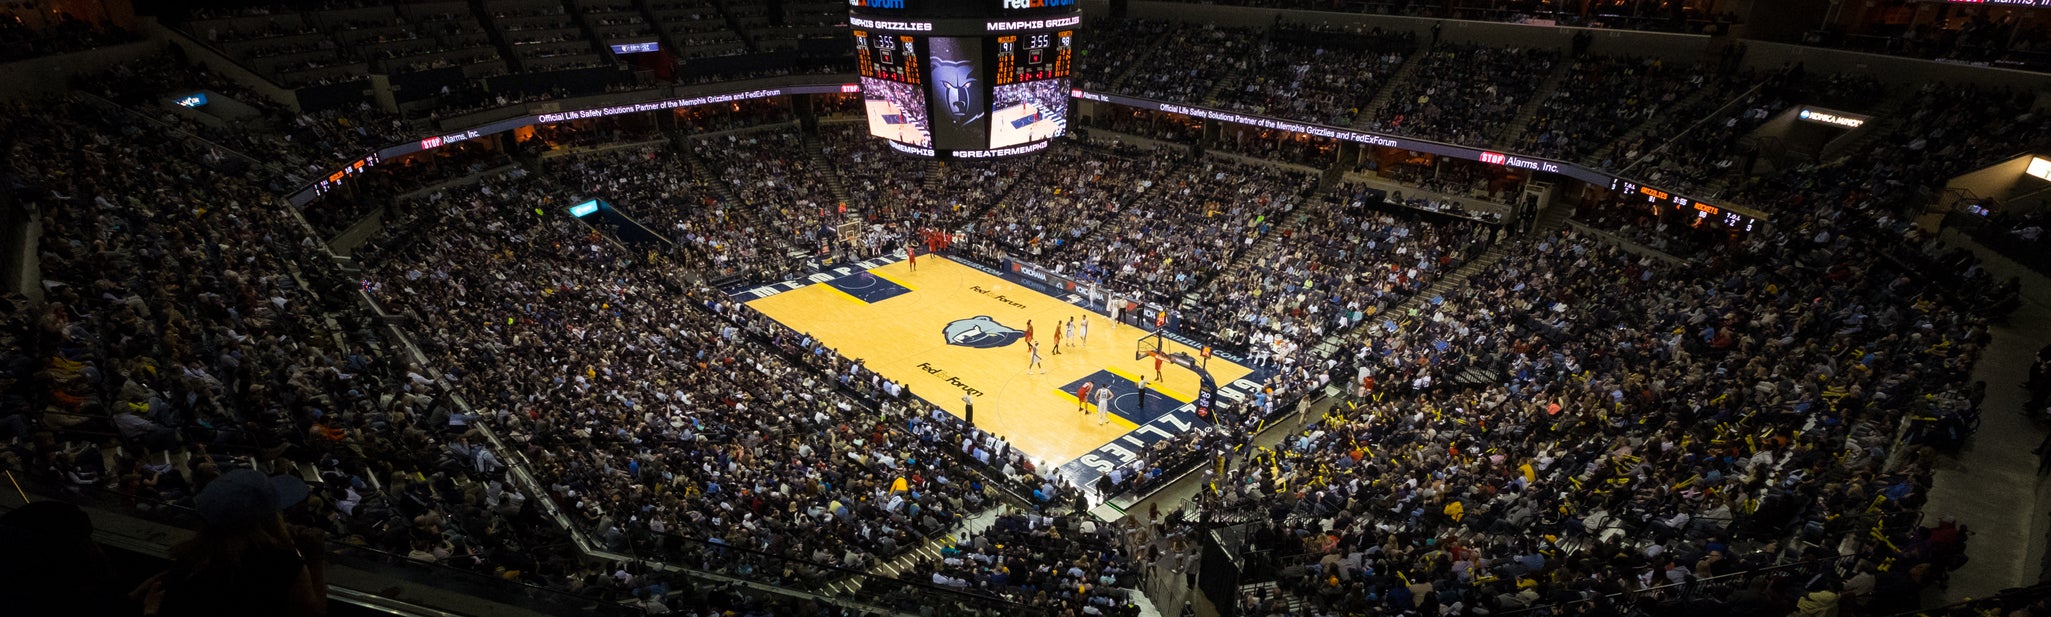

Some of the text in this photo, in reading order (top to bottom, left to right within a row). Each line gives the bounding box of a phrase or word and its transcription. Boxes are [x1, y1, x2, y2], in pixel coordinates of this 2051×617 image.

[875, 21, 932, 31] GRIZZLIES
[987, 16, 1080, 31] MEMPHIS GRIZZLIES
[538, 89, 780, 123] Official Life Safety Solutions Partner of the Memphis Grizzlies and FedExForum
[1159, 103, 1397, 148] Official Life Safety Solutions Partner of the Memphis Grizzlies and FedExForum
[1809, 112, 1836, 123] KONICA
[953, 141, 1048, 158] #GREATERMEMPHIS
[1481, 153, 1560, 173] STOP Alarms, Inc.
